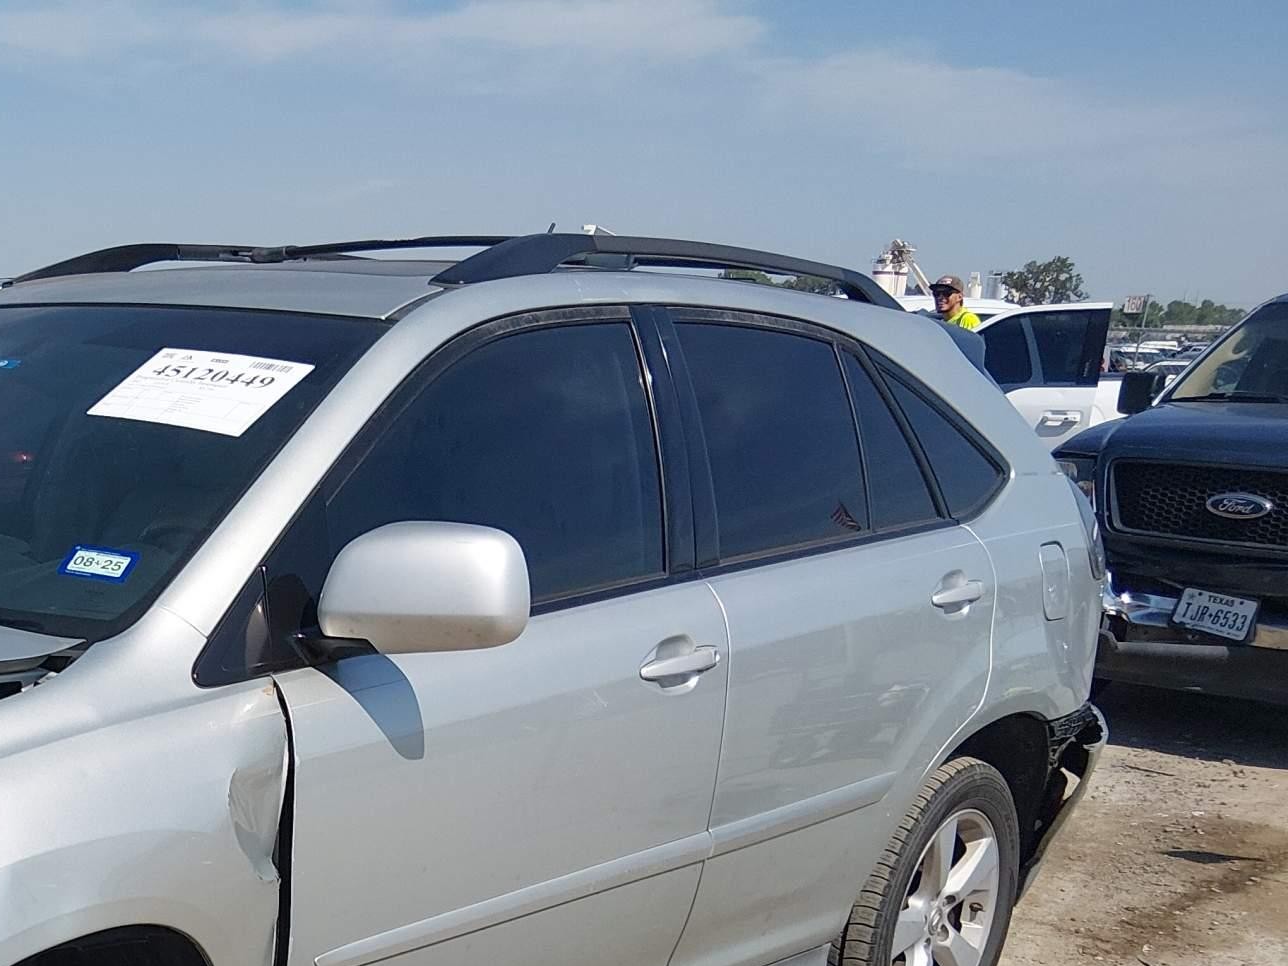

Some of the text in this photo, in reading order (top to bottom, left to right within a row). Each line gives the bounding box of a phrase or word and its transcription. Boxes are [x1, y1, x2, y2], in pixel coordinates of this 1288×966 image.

[153, 364, 275, 388] 45120449
[1218, 499, 1255, 513] Ford
[1208, 594, 1235, 607] TEXAS
